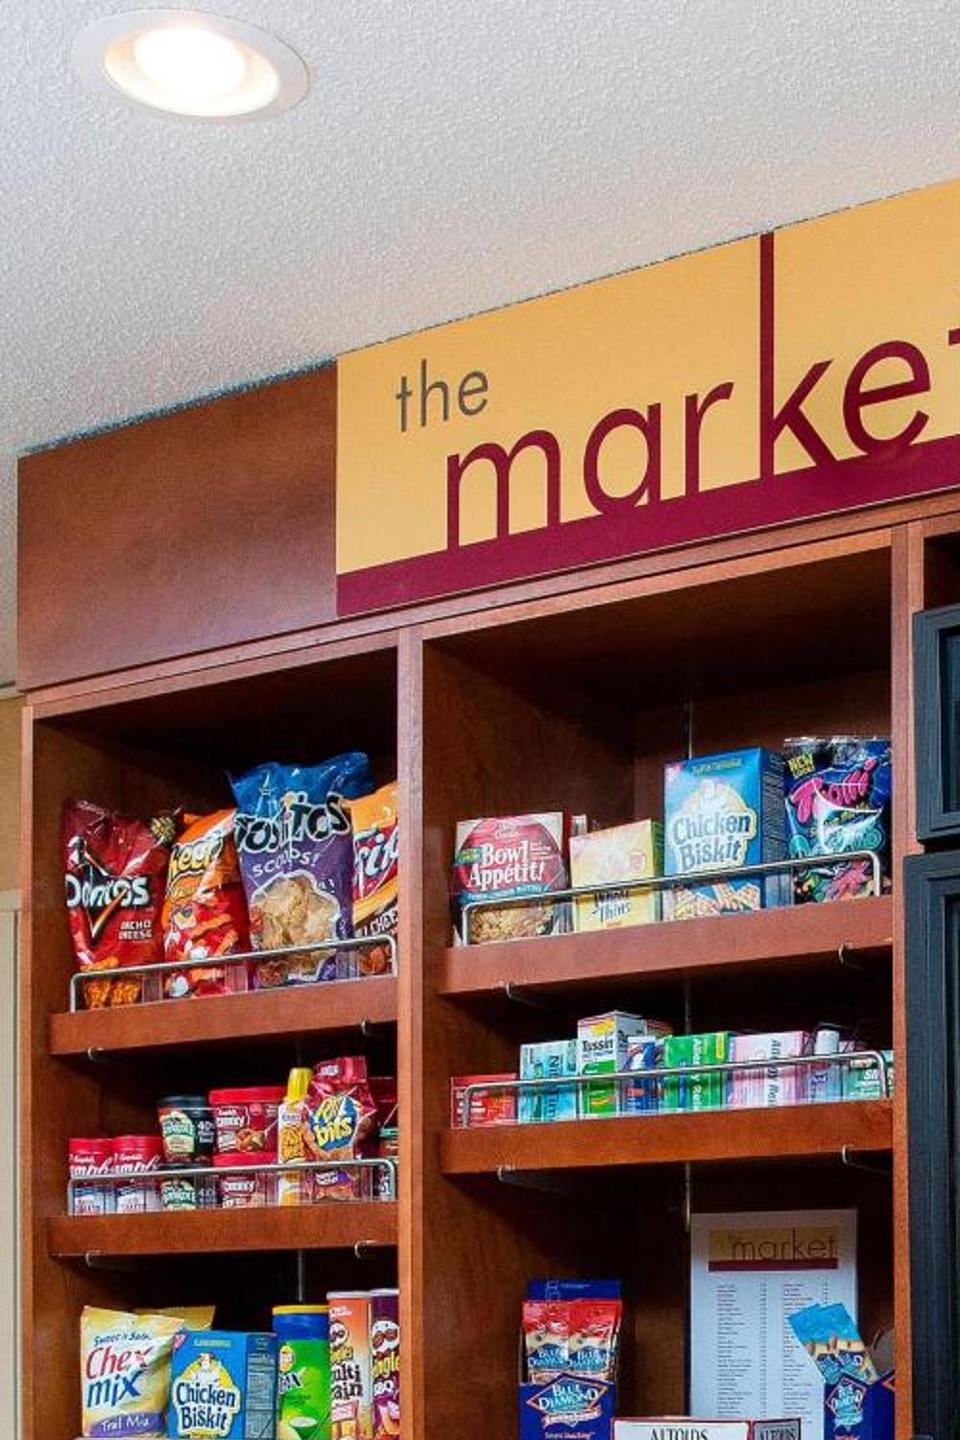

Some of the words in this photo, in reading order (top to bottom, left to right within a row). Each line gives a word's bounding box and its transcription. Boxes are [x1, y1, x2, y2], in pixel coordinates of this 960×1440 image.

[395, 358, 489, 432] the
[672, 812, 750, 846] Chicken
[480, 840, 530, 868] Bowl
[680, 836, 742, 870] Biskit
[731, 1228, 838, 1261] market
[86, 1345, 155, 1380] Chex
[86, 1370, 144, 1408] mix
[175, 1381, 236, 1408] Chicken
[331, 1382, 364, 1401] ain
[181, 1402, 229, 1432] Biskit
